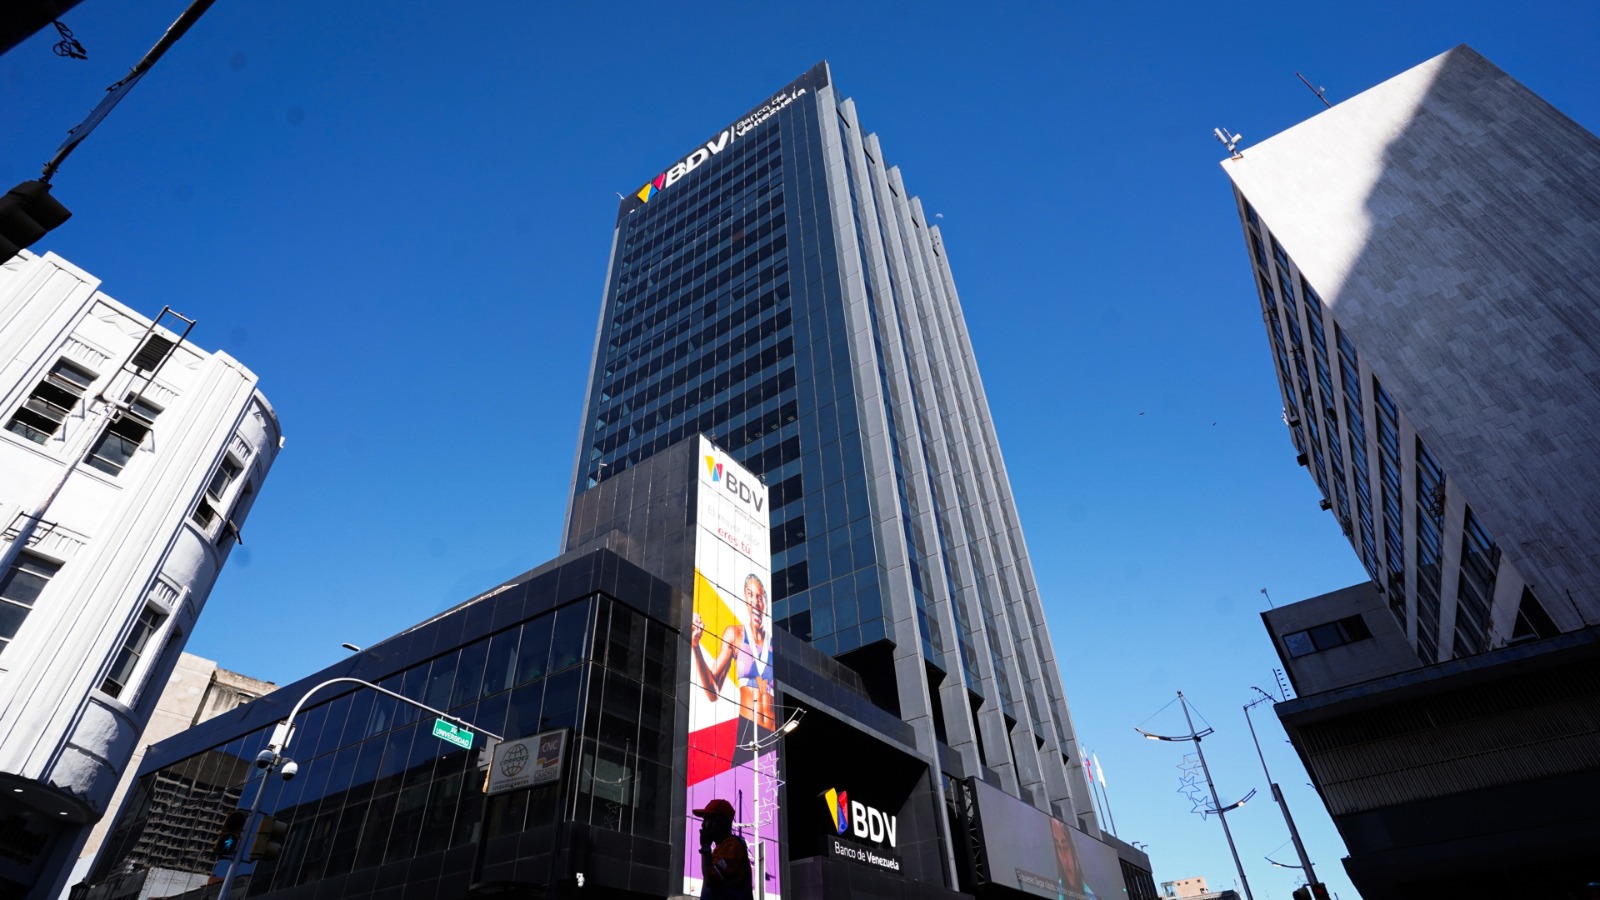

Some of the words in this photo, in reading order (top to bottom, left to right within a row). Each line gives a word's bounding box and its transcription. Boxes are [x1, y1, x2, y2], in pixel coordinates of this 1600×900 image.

[736, 105, 771, 130] Banco
[772, 93, 787, 106] de
[736, 86, 807, 137] Venezuela
[666, 130, 730, 188] BDV
[726, 471, 763, 513] BDV
[717, 527, 739, 546] eres
[741, 541, 751, 555] tú
[435, 728, 469, 747] UNIVERSIDAD
[542, 740, 559, 752] CNC
[851, 800, 897, 848] BDV
[834, 841, 856, 859] Banco
[857, 849, 866, 861] de
[866, 850, 899, 871] Venezuela
